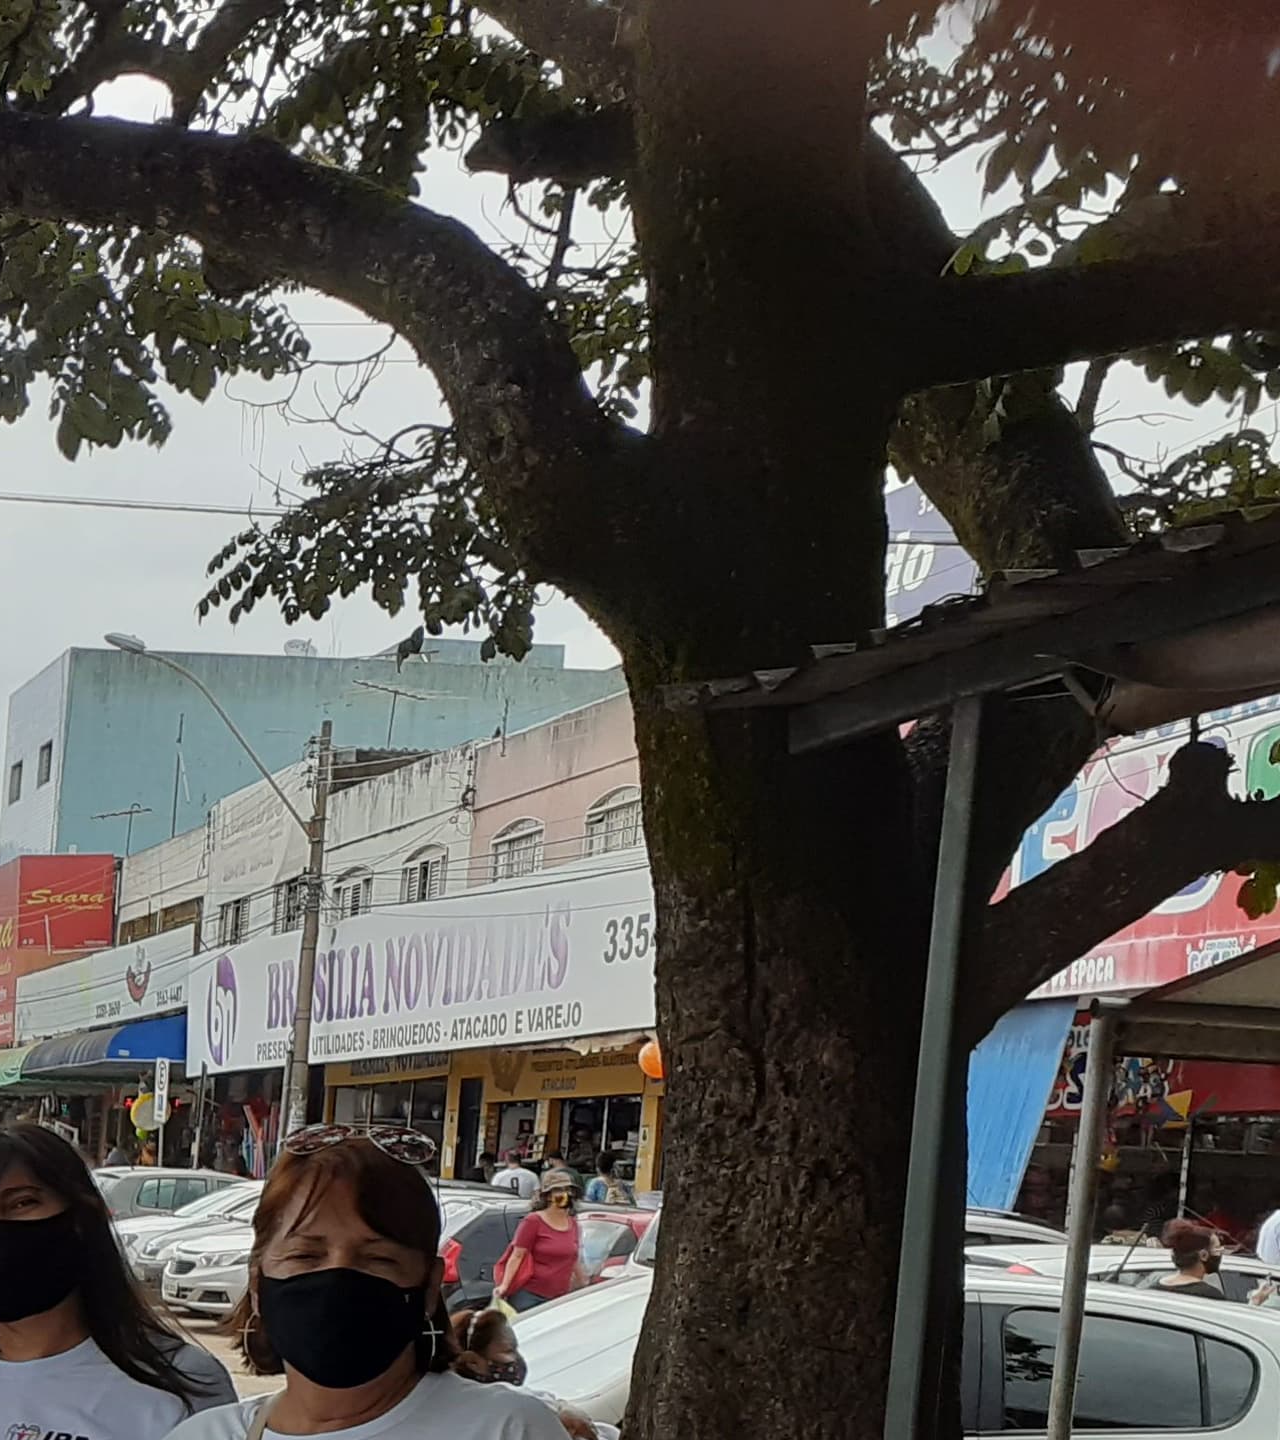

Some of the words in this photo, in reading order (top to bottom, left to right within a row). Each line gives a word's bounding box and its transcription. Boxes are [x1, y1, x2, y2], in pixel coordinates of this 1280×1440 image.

[27, 890, 106, 905] Saara
[266, 928, 377, 1030] BRSÍLIA
[603, 912, 656, 964] 335
[312, 1031, 365, 1056] UTILIDADES
[372, 1021, 441, 1050] BRINQUEDOS
[450, 1013, 507, 1042] ATACADO
[515, 1010, 523, 1035] E
[527, 1002, 582, 1033] VAREJO
